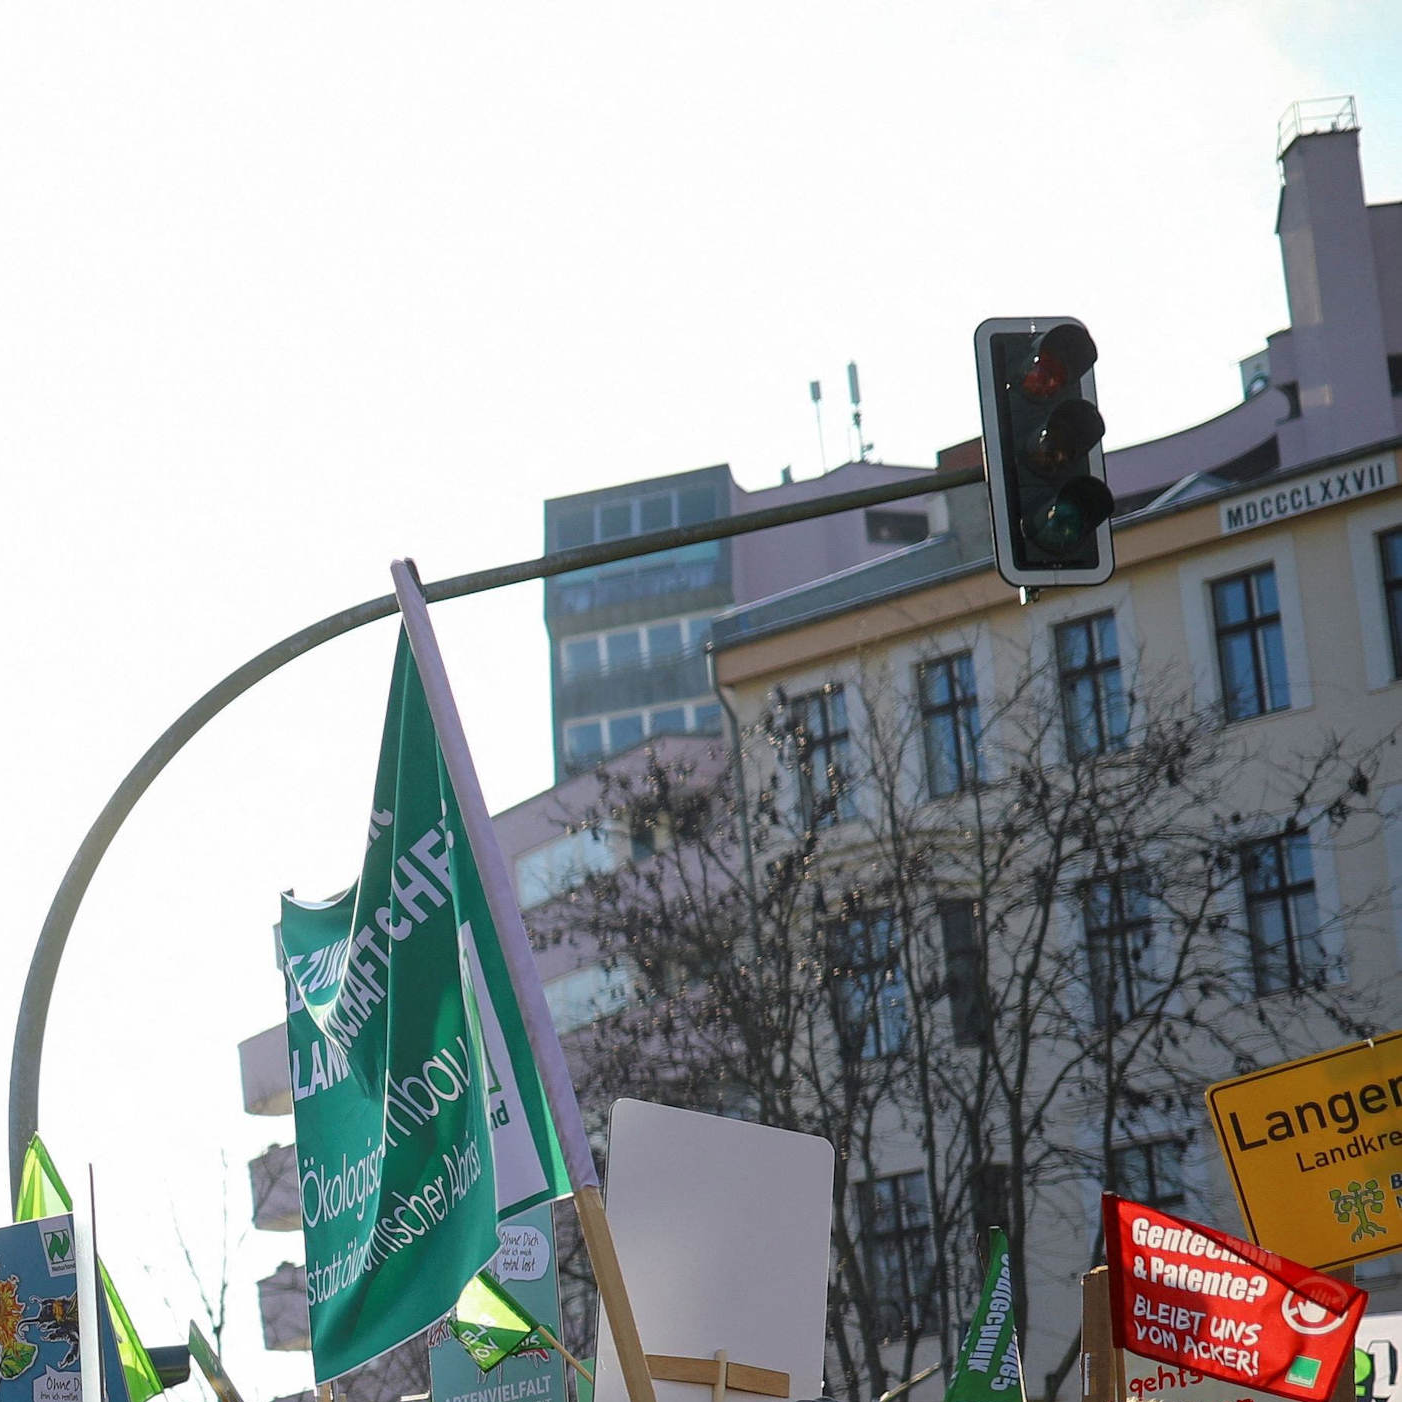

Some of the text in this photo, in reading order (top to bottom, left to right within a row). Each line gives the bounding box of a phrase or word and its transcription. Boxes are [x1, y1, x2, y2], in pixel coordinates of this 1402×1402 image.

[1227, 463, 1384, 529] MDCCCLXXVII
[1132, 1255, 1269, 1303] & Patente?
[1133, 1293, 1264, 1347] BLEIBT UNS
[1133, 1319, 1260, 1378] VOM ACKER!
